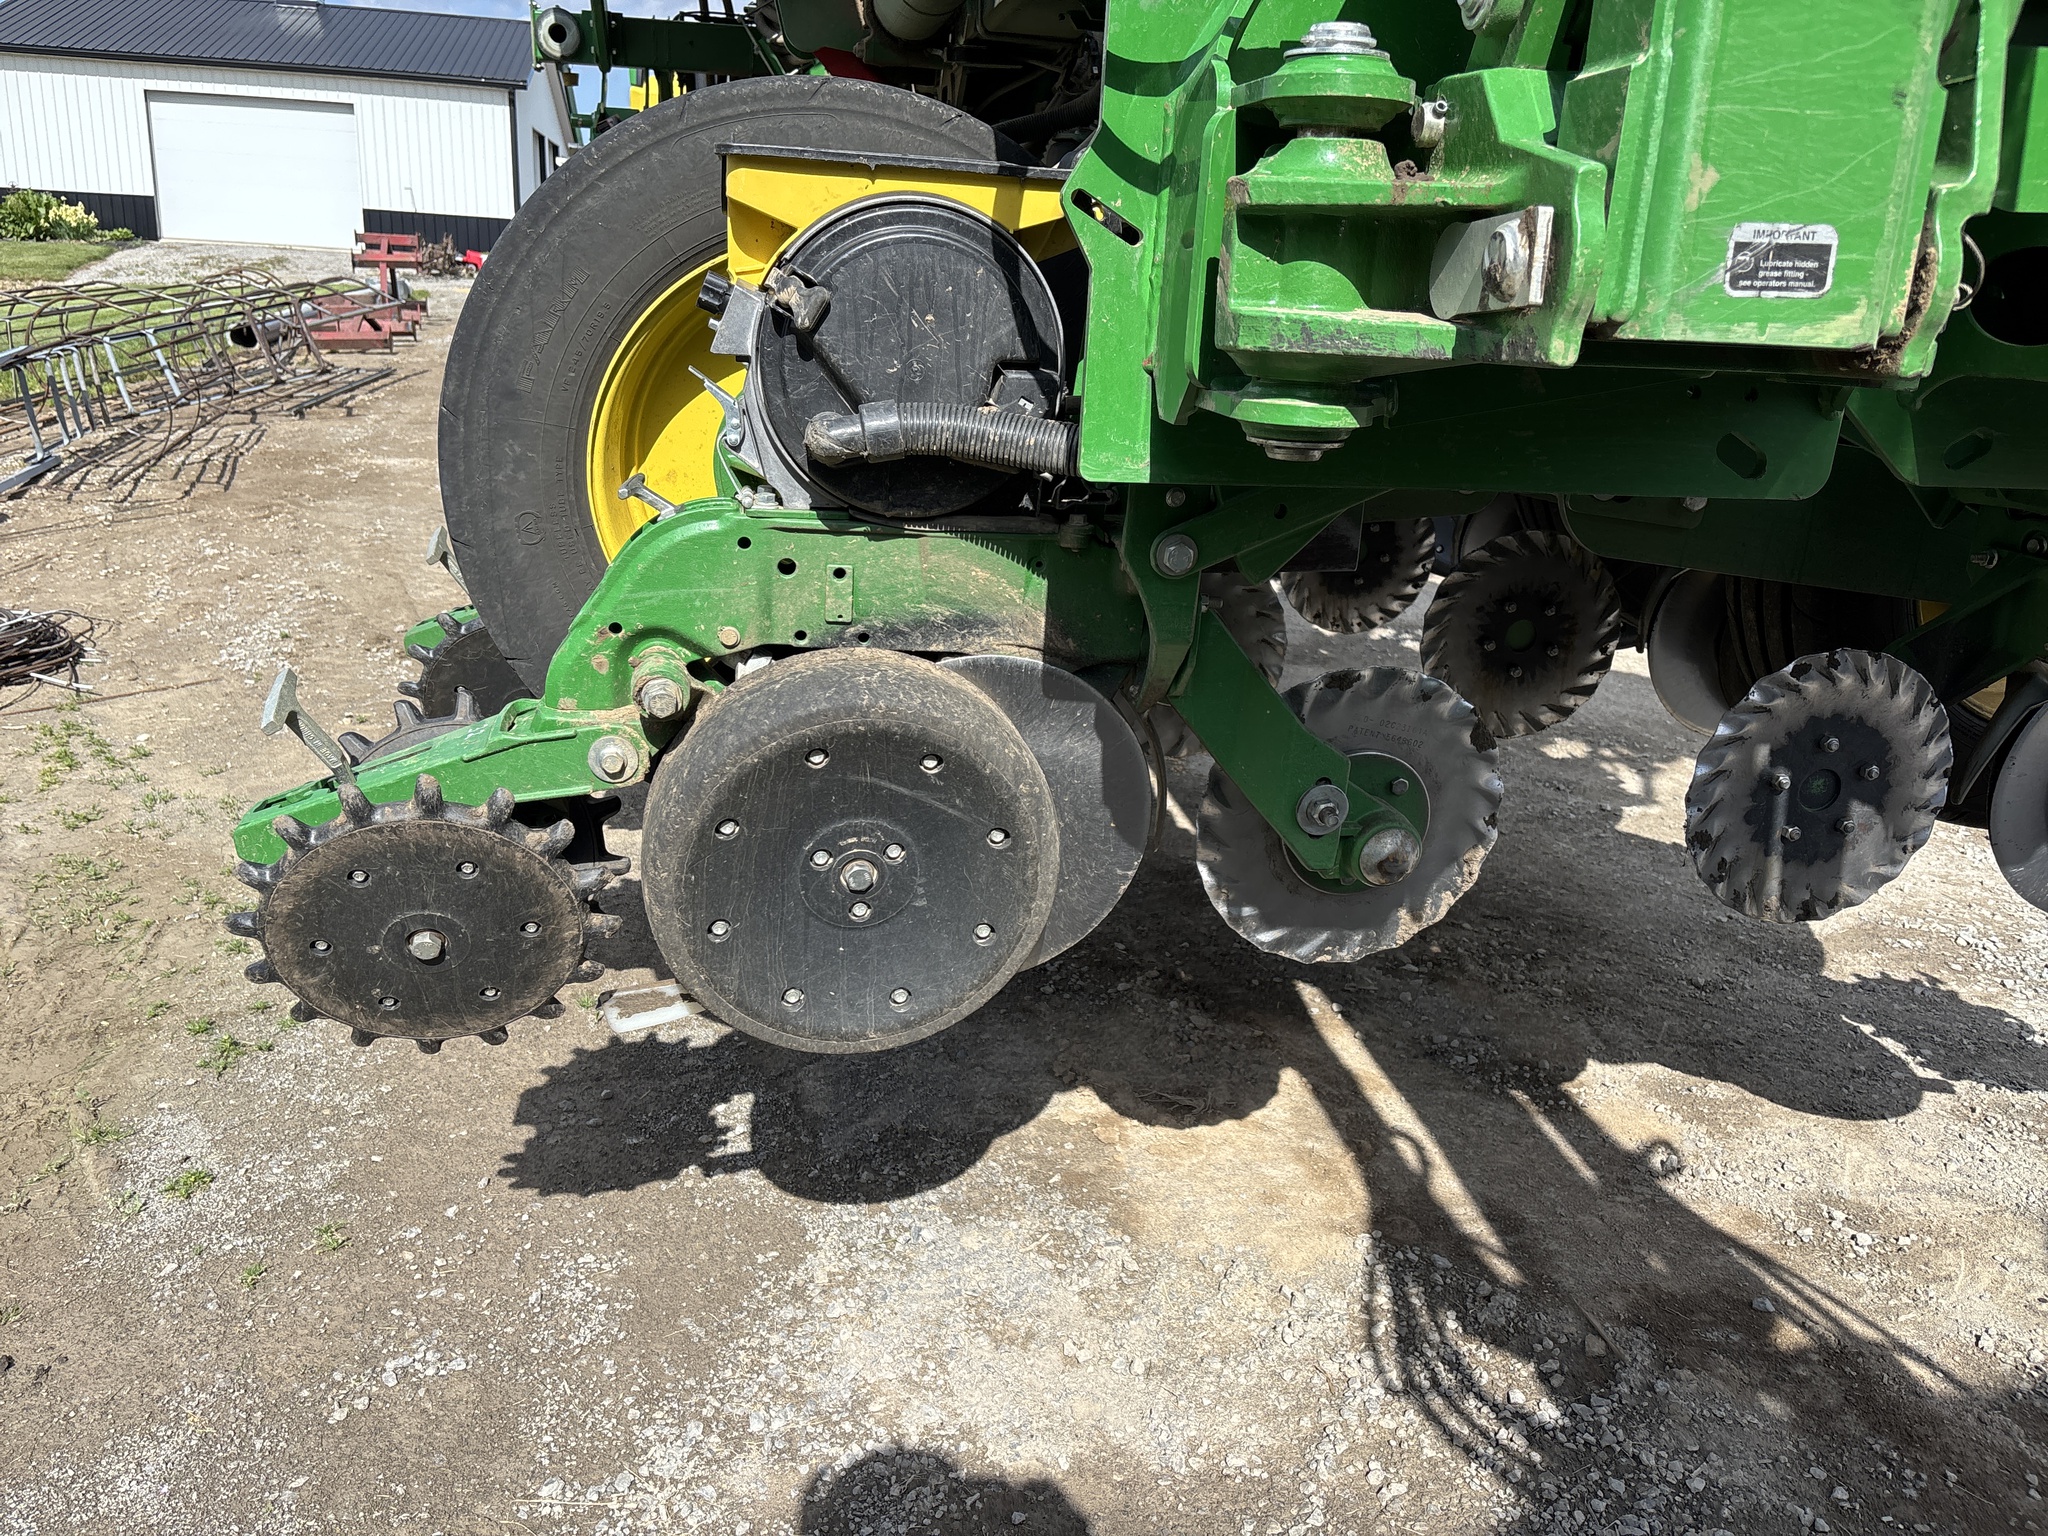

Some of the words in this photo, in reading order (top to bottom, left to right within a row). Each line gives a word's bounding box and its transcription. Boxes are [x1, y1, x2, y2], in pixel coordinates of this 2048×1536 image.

[1752, 228, 1817, 241] IMPORTANT
[1759, 259, 1793, 268] Lubricate
[1794, 260, 1819, 269] hidden
[1758, 269, 1782, 278] grease
[1783, 269, 1804, 278] fitting
[1752, 280, 1787, 288] operators
[1788, 279, 1816, 288] manual.
[517, 265, 591, 395] FARM
